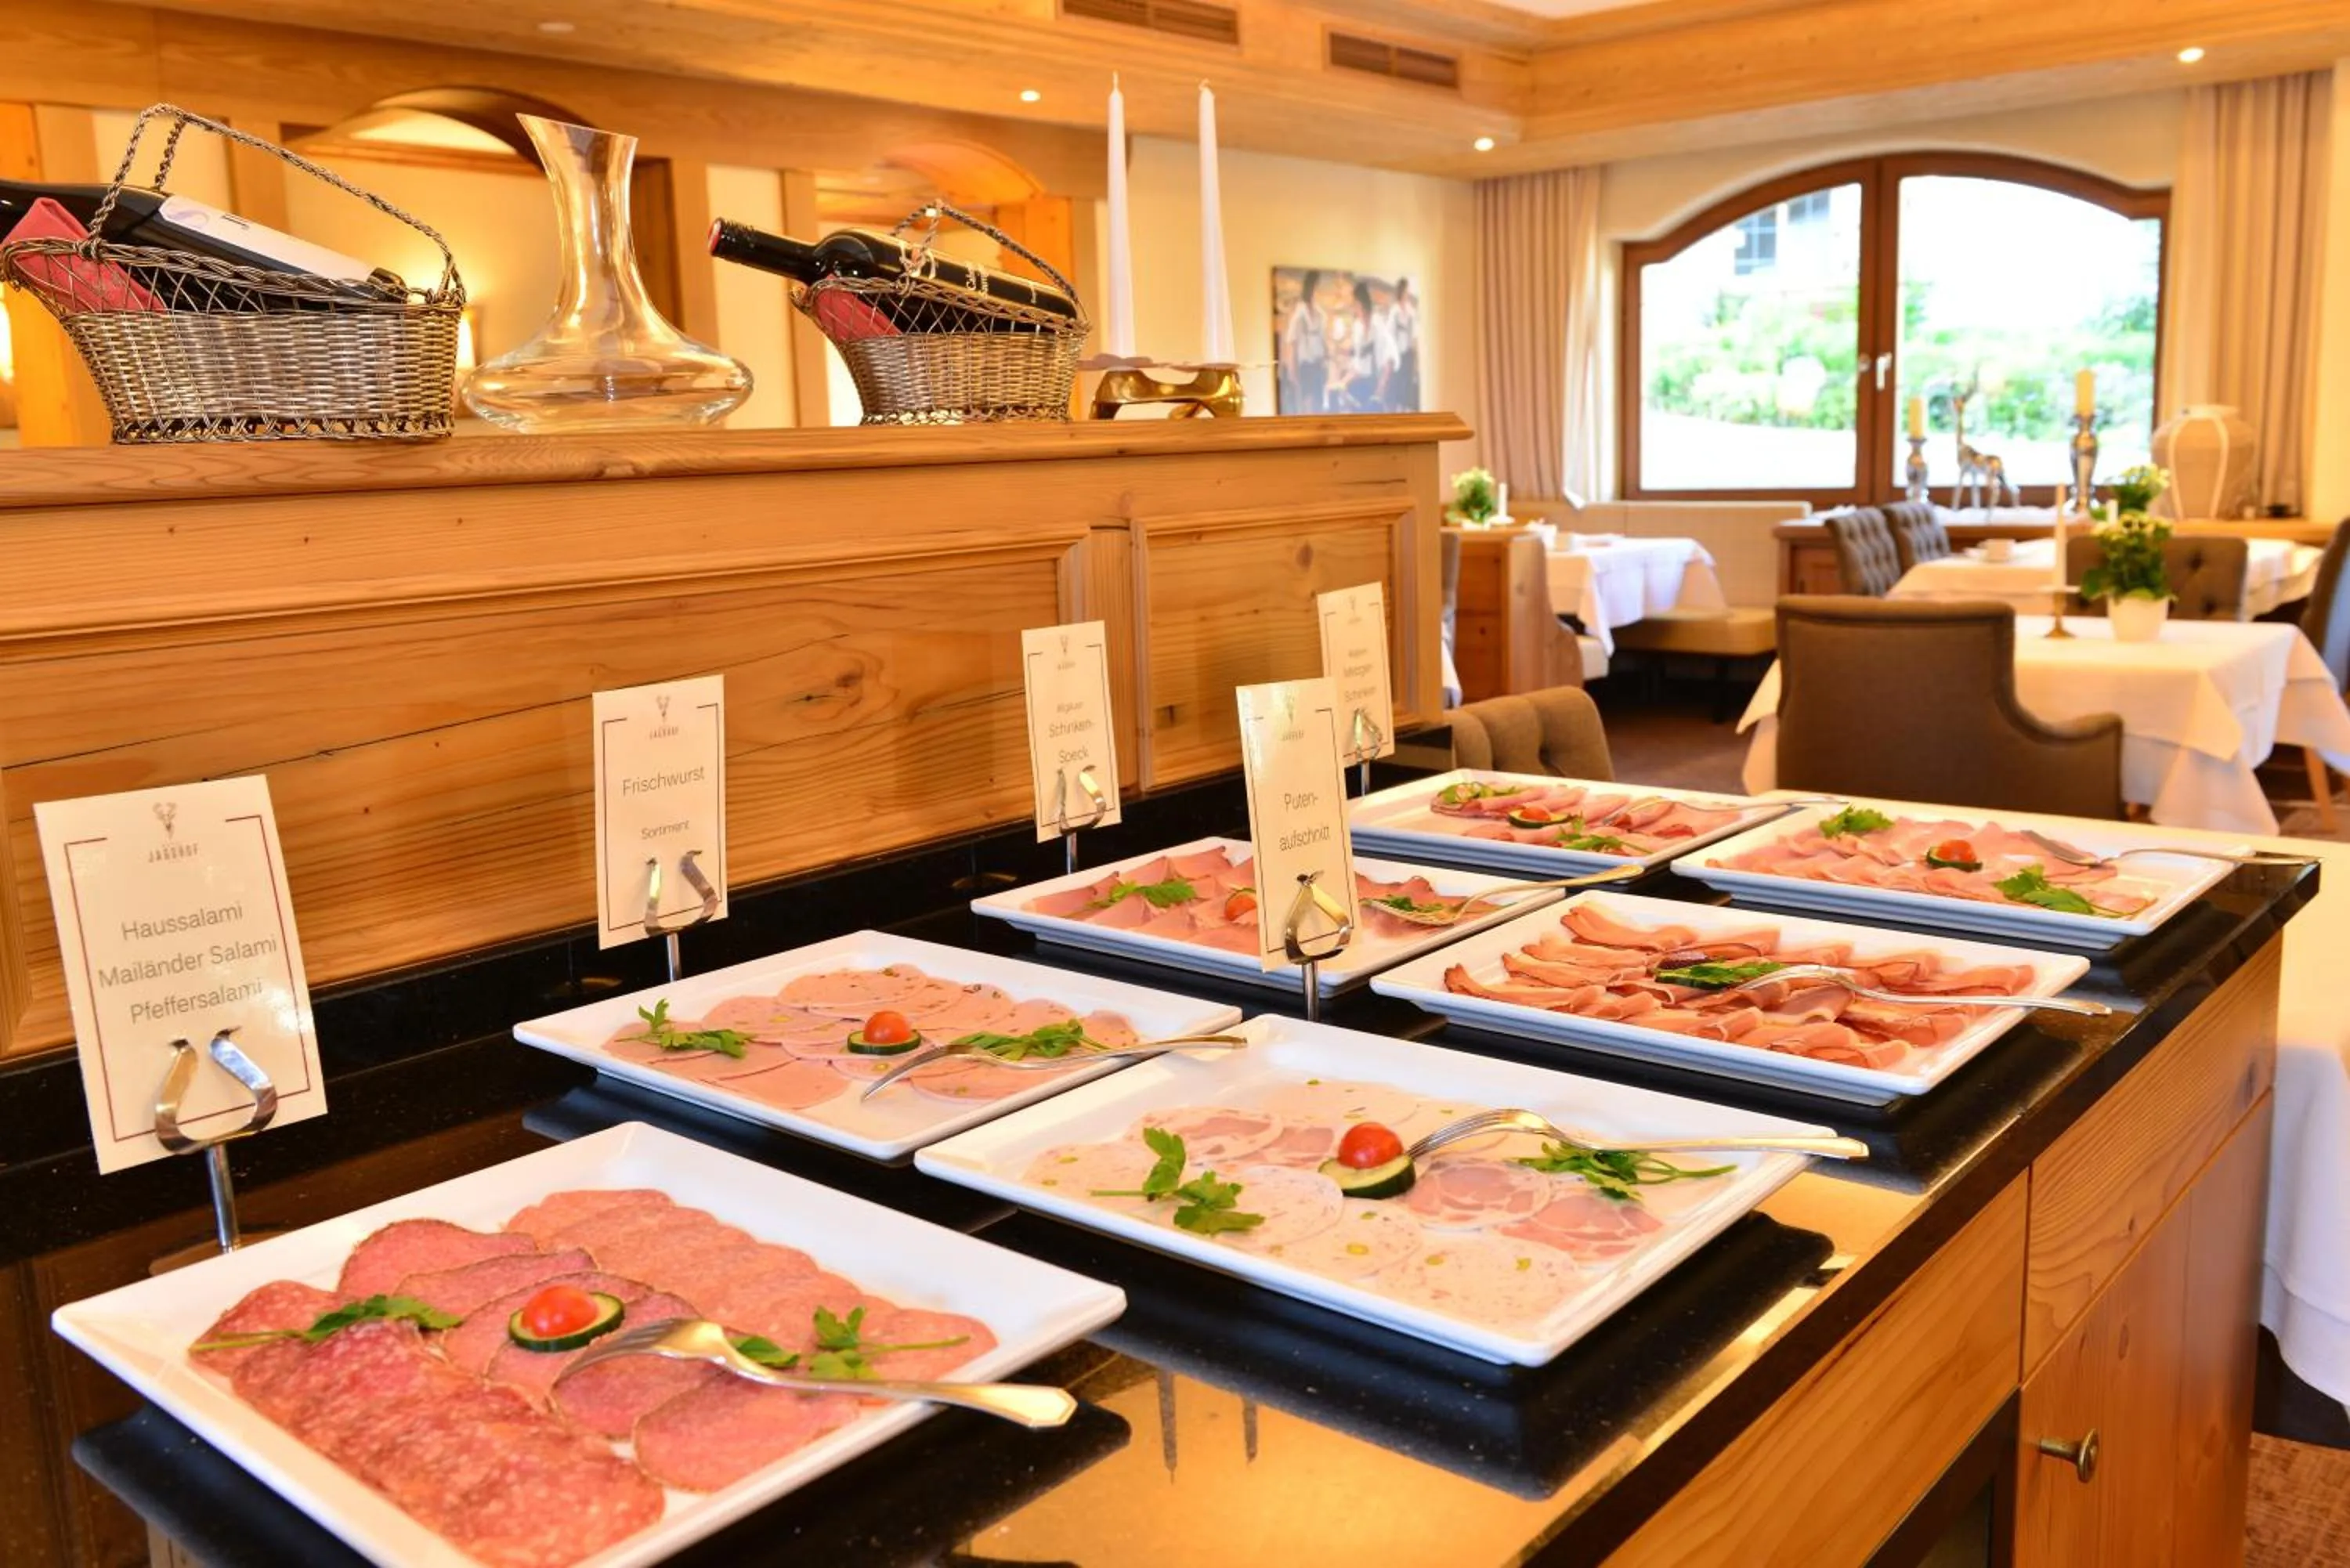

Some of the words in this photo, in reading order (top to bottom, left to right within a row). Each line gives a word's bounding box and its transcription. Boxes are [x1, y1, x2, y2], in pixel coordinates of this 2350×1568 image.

[623, 766, 704, 797] Frischwurst
[1284, 793, 1317, 813] Puten-
[642, 820, 689, 839] Sortiment
[1279, 825, 1330, 851] aufschnitt
[122, 901, 243, 941] Haussalami
[99, 950, 204, 988] Mailänder
[211, 938, 277, 966] Salami
[130, 980, 262, 1023] Pfeffersalami
